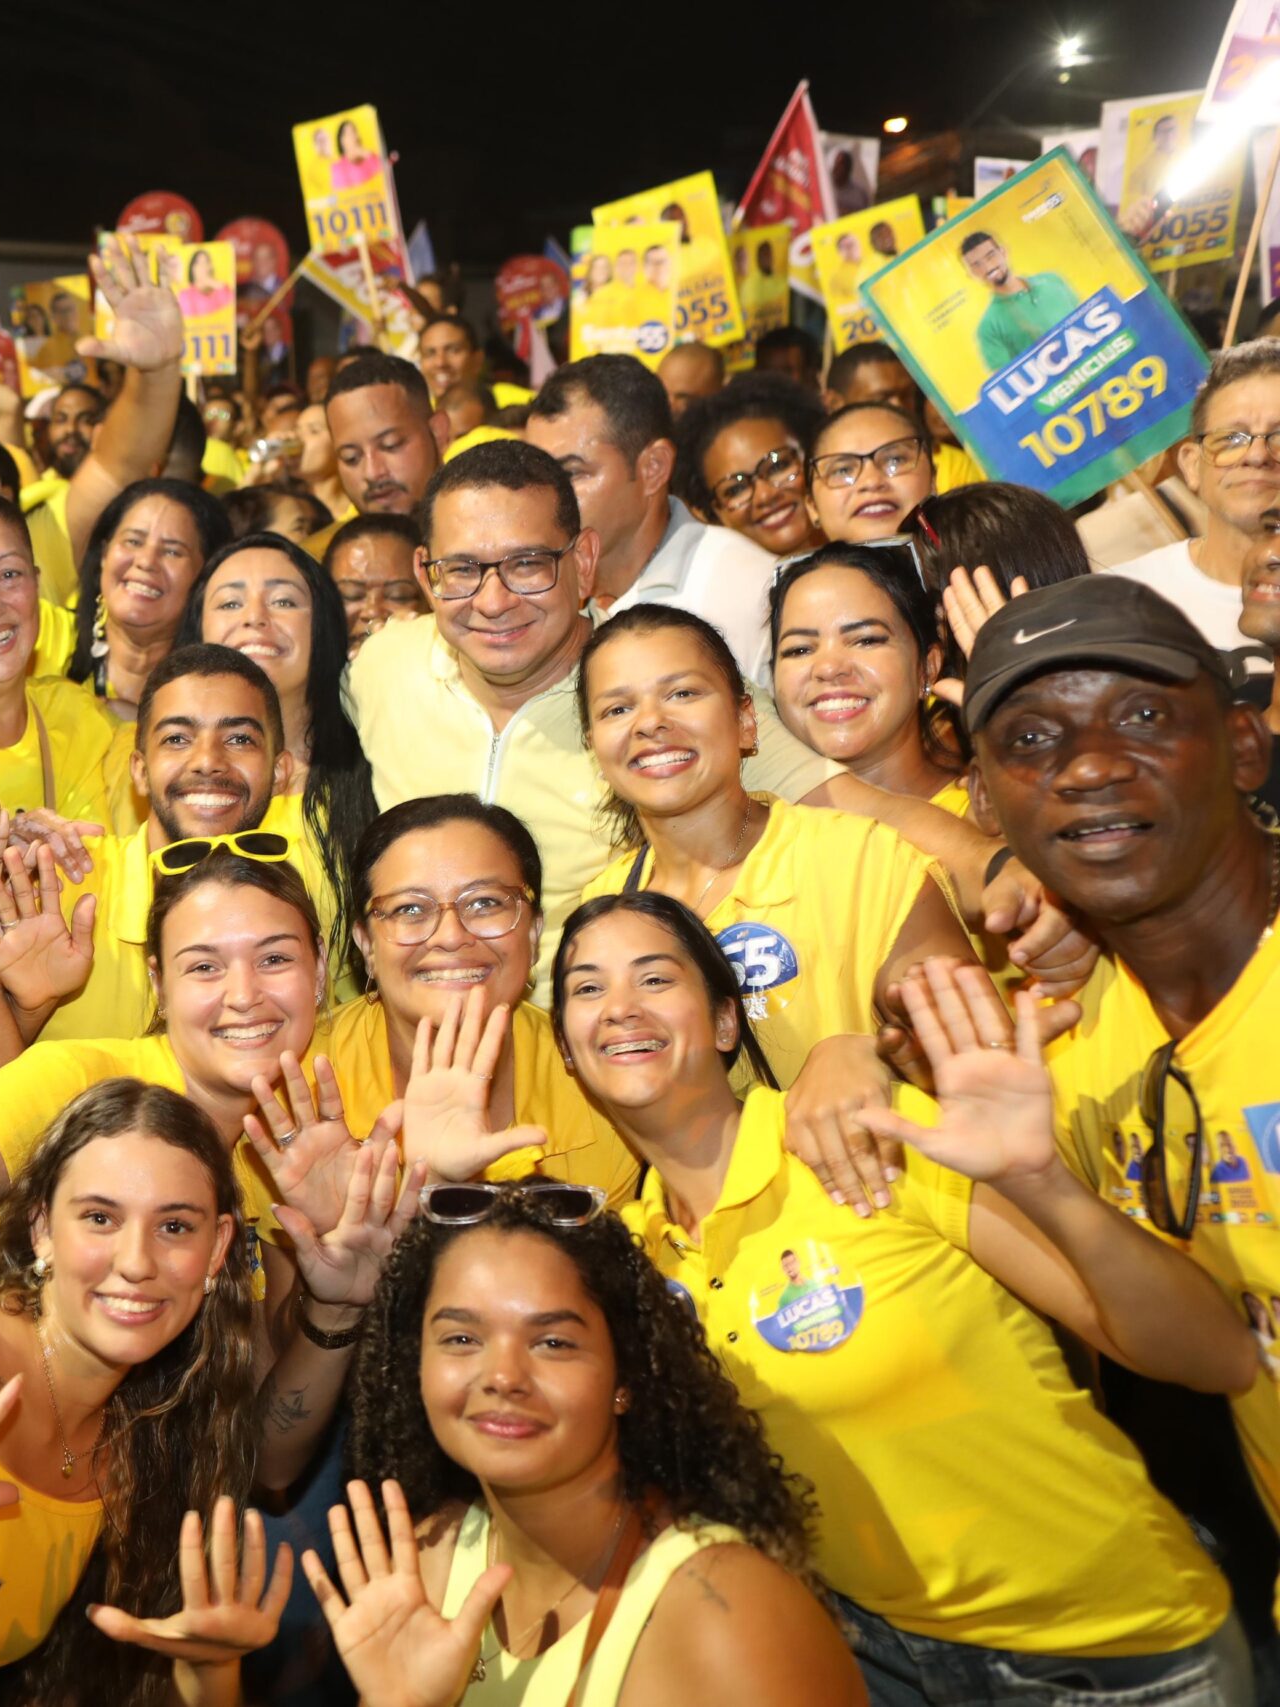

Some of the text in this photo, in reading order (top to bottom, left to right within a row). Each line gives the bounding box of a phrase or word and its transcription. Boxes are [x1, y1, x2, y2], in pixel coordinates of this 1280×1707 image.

[313, 201, 388, 238] 10111
[987, 301, 1122, 416] LUCAS
[1038, 332, 1134, 408] VENICIUS
[1019, 355, 1168, 469] 10789
[776, 1287, 838, 1329] LUCAS
[787, 1320, 845, 1350] 10789
